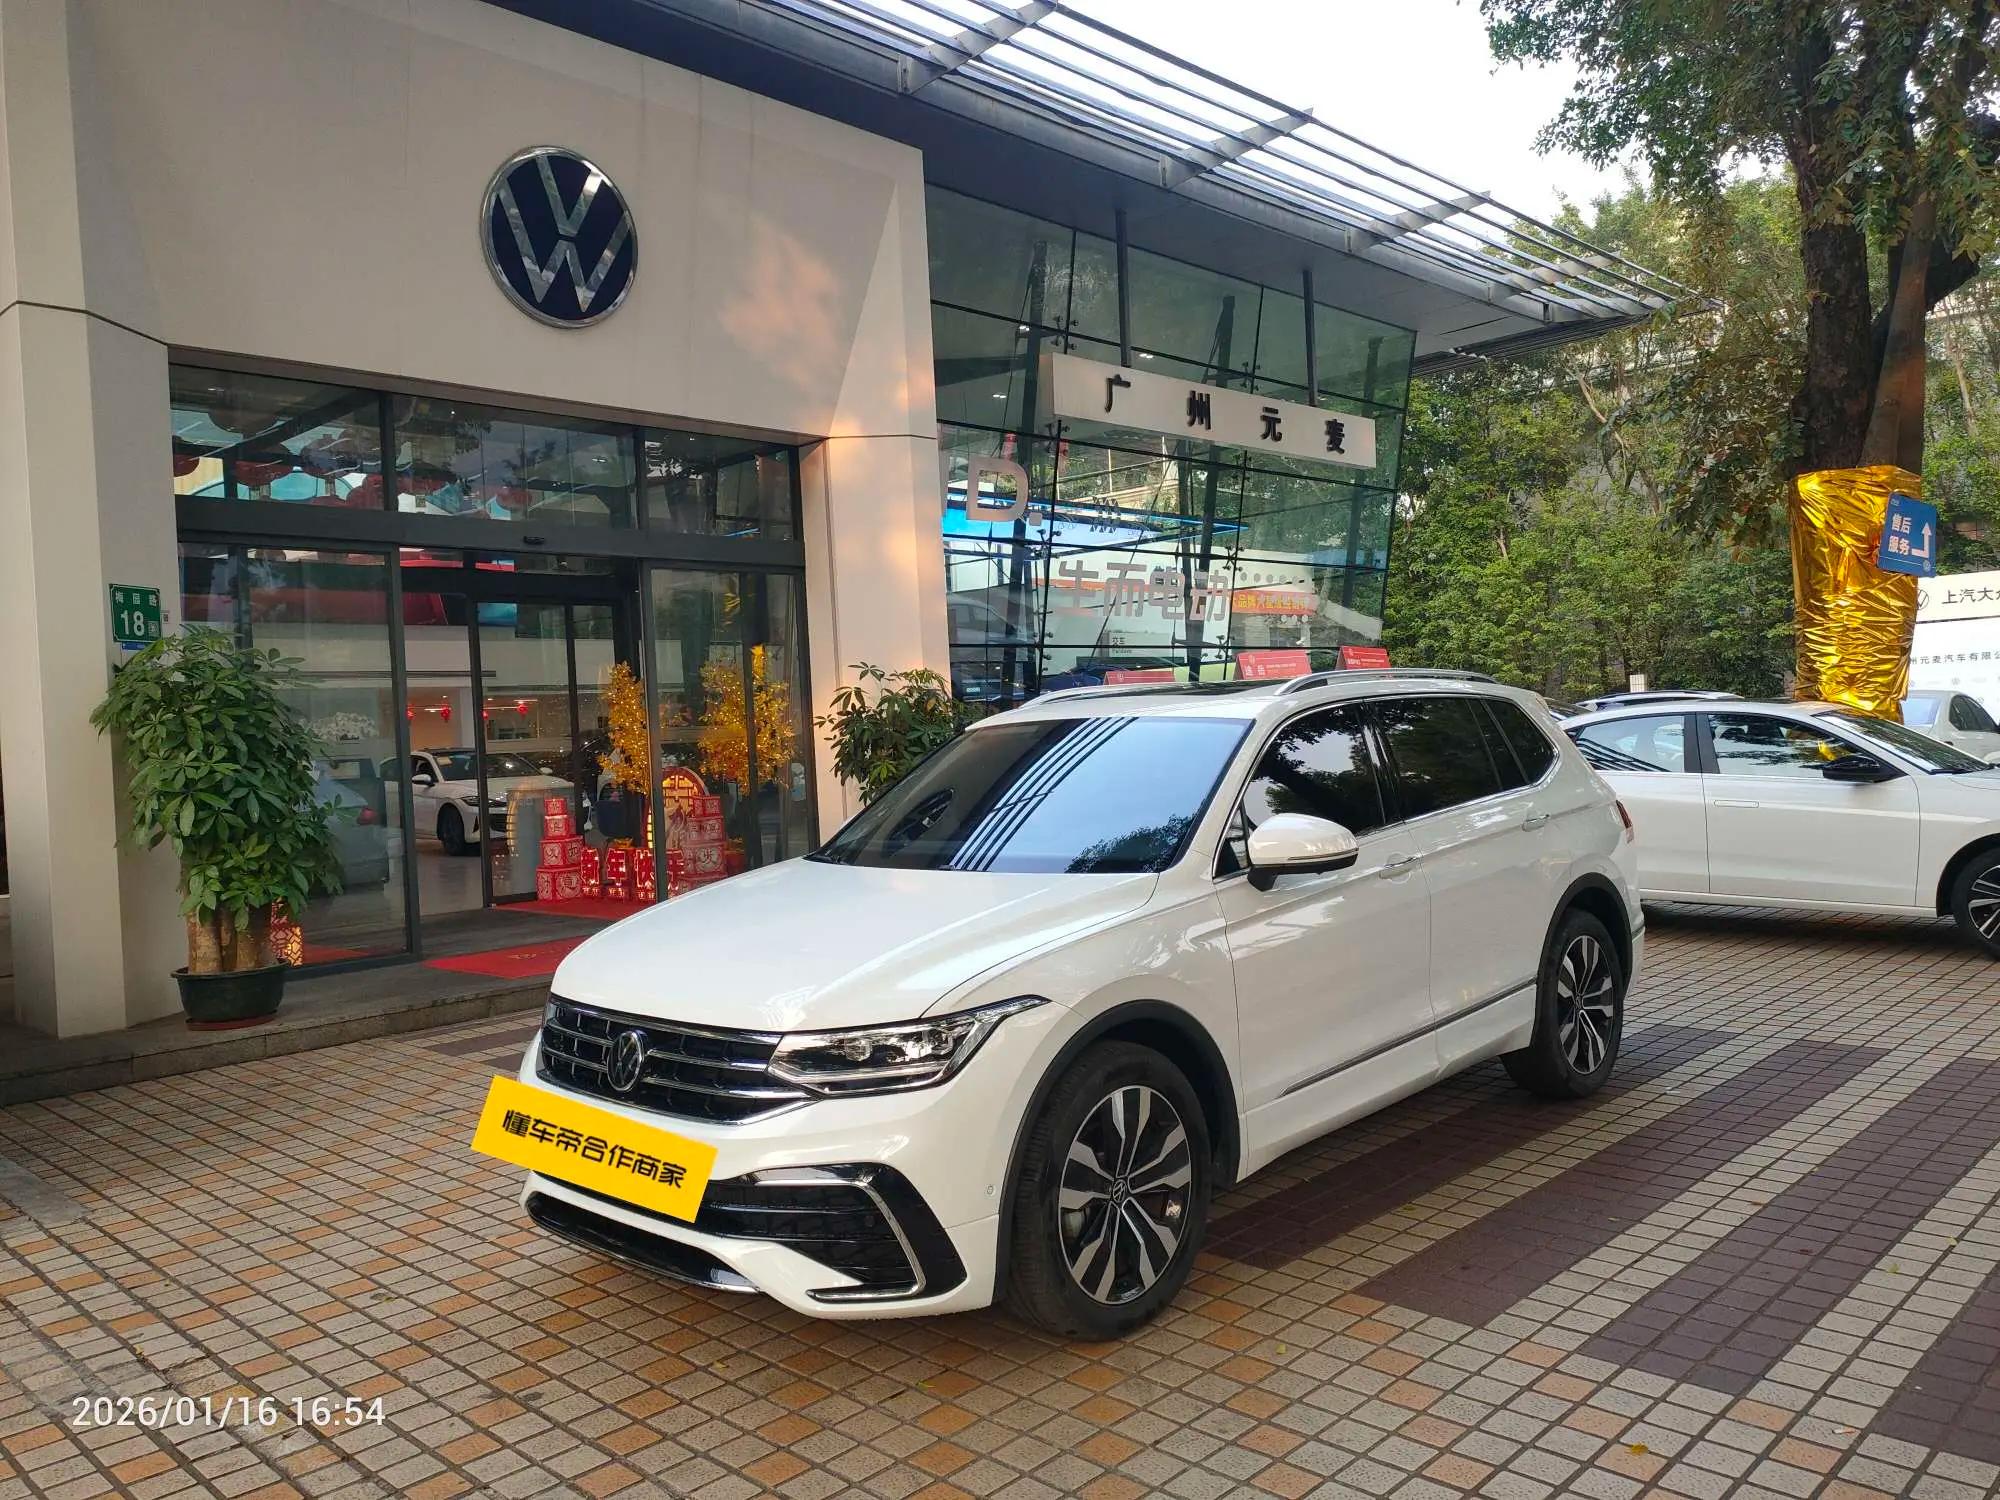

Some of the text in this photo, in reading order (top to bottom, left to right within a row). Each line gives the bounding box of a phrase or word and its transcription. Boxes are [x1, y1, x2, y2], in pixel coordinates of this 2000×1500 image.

[1104, 373, 1346, 455] 广州元麦
[1890, 512, 1913, 534] 售后
[1887, 534, 1911, 557] 服务
[1056, 559, 1230, 622] 生而电动
[120, 609, 145, 637] 18
